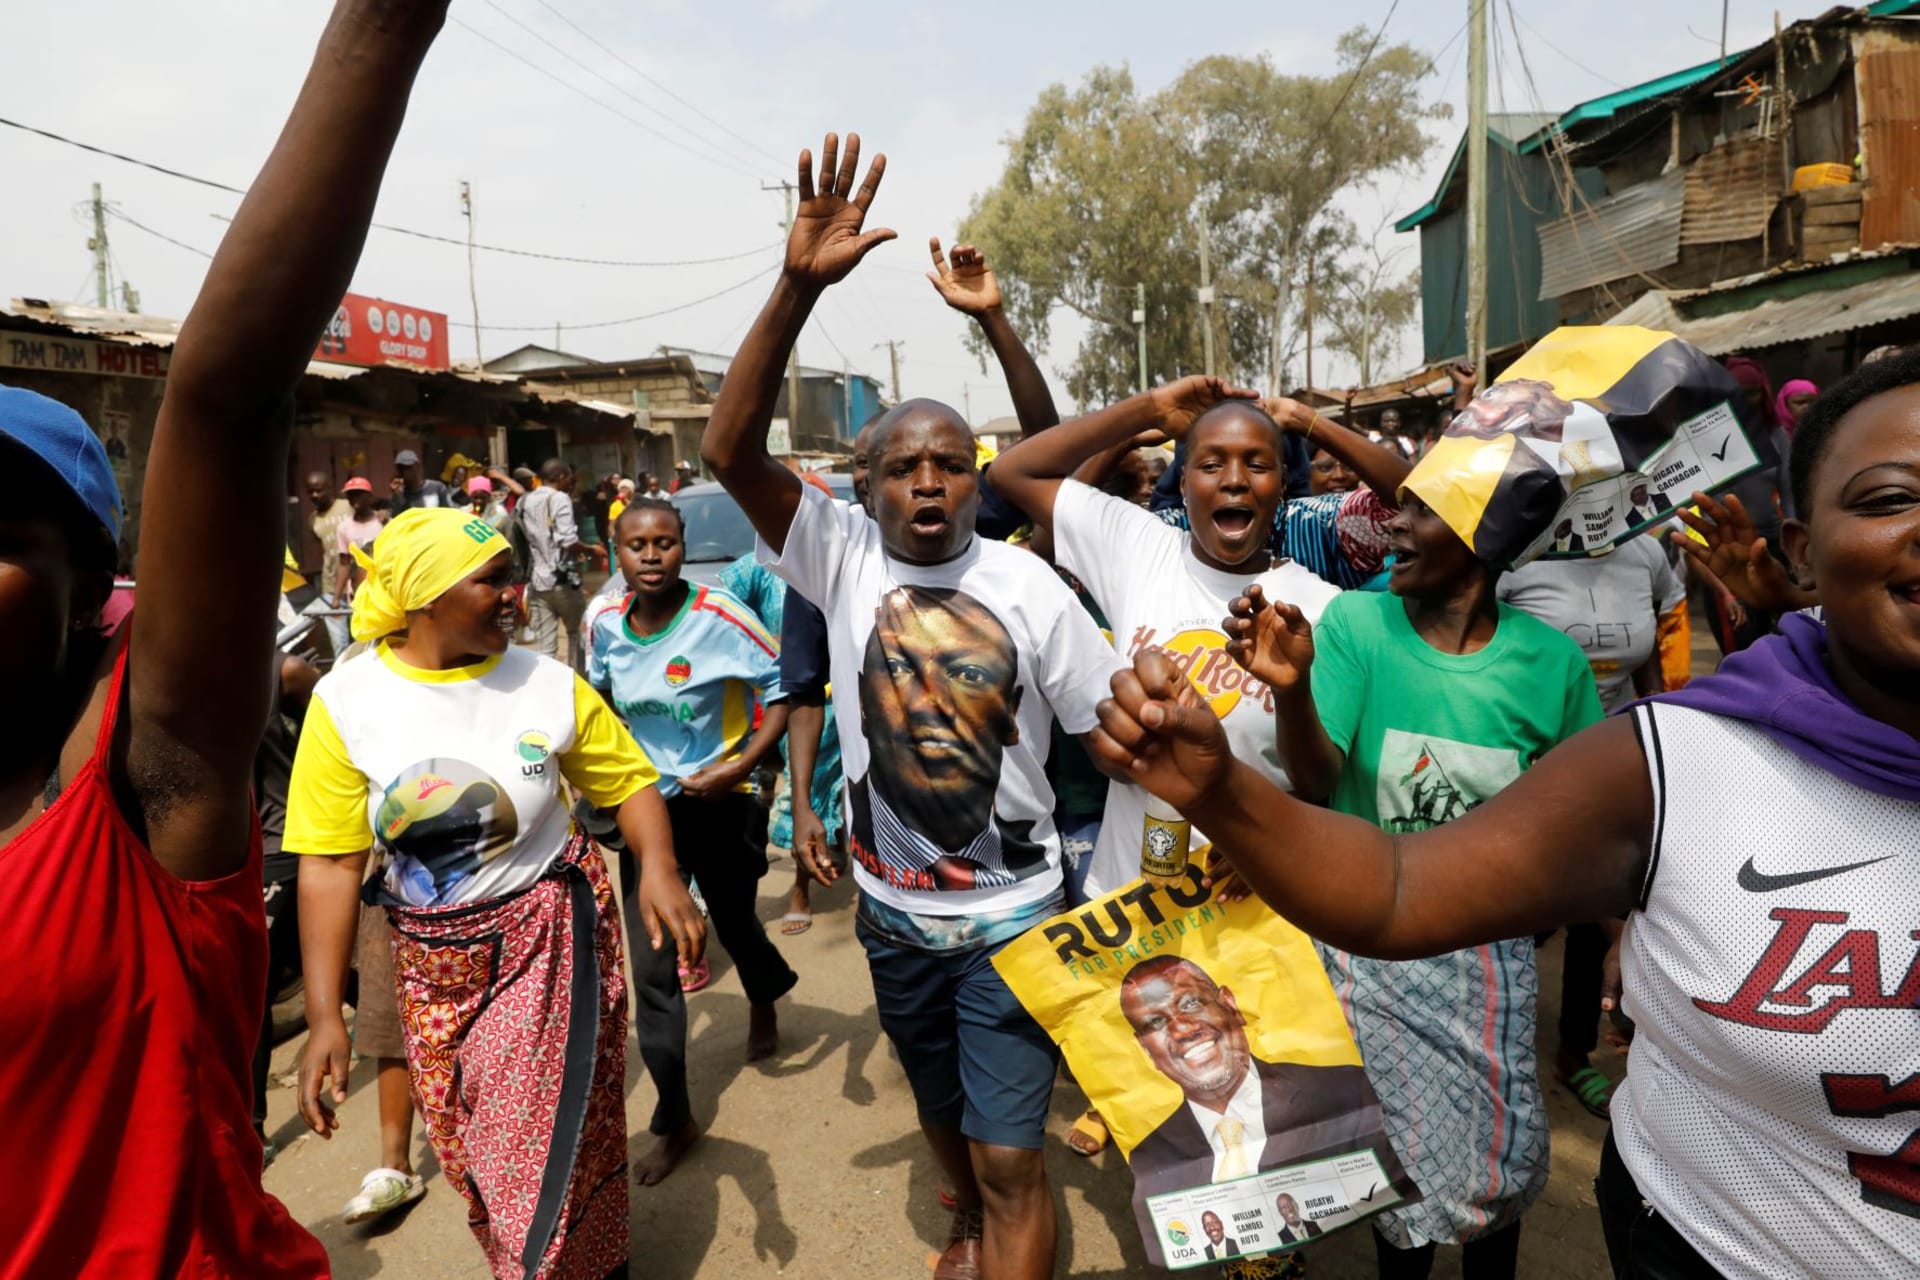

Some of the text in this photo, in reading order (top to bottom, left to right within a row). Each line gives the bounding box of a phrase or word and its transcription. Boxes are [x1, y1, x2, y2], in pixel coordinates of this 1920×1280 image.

[9, 338, 47, 367] TAM
[1657, 464, 1701, 492] GACHAGUA
[1587, 529, 1608, 543] RUTO
[1042, 863, 1213, 965] RUTO
[1067, 899, 1229, 982] FOR PRESIDENT
[1304, 1195, 1335, 1209] RIGATHI
[1232, 1208, 1263, 1222] WILLIAM
[1240, 1234, 1260, 1246] RUTO
[1172, 1248, 1198, 1259] UDA
